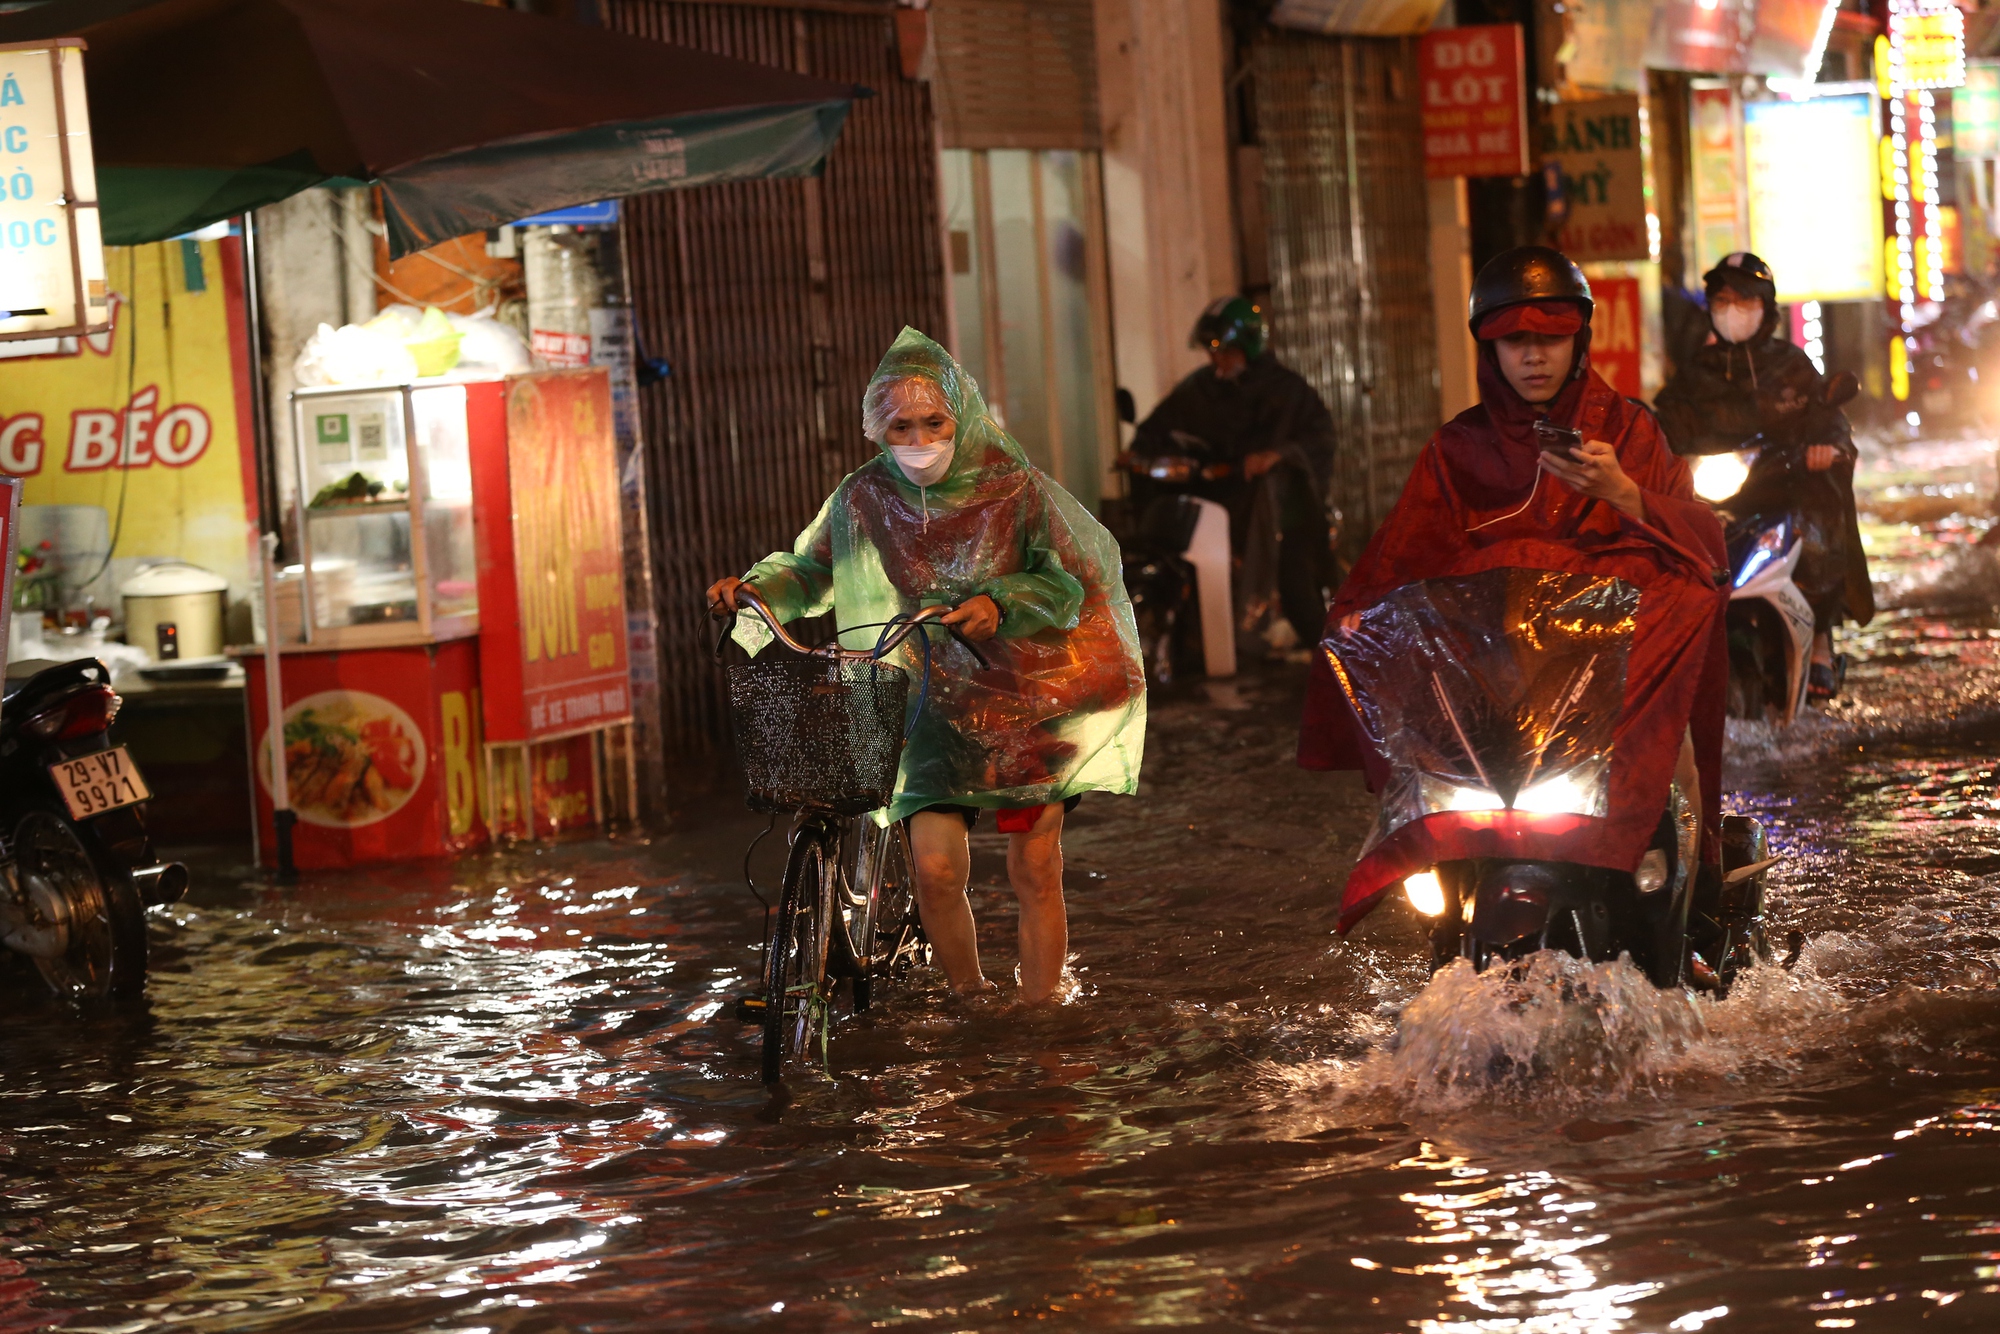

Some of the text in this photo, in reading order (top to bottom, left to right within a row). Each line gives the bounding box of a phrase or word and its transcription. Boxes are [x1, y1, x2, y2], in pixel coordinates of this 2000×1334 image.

[0, 218, 57, 254] ỌC
[65, 386, 211, 470] BÉO
[75, 775, 138, 813] 9921
